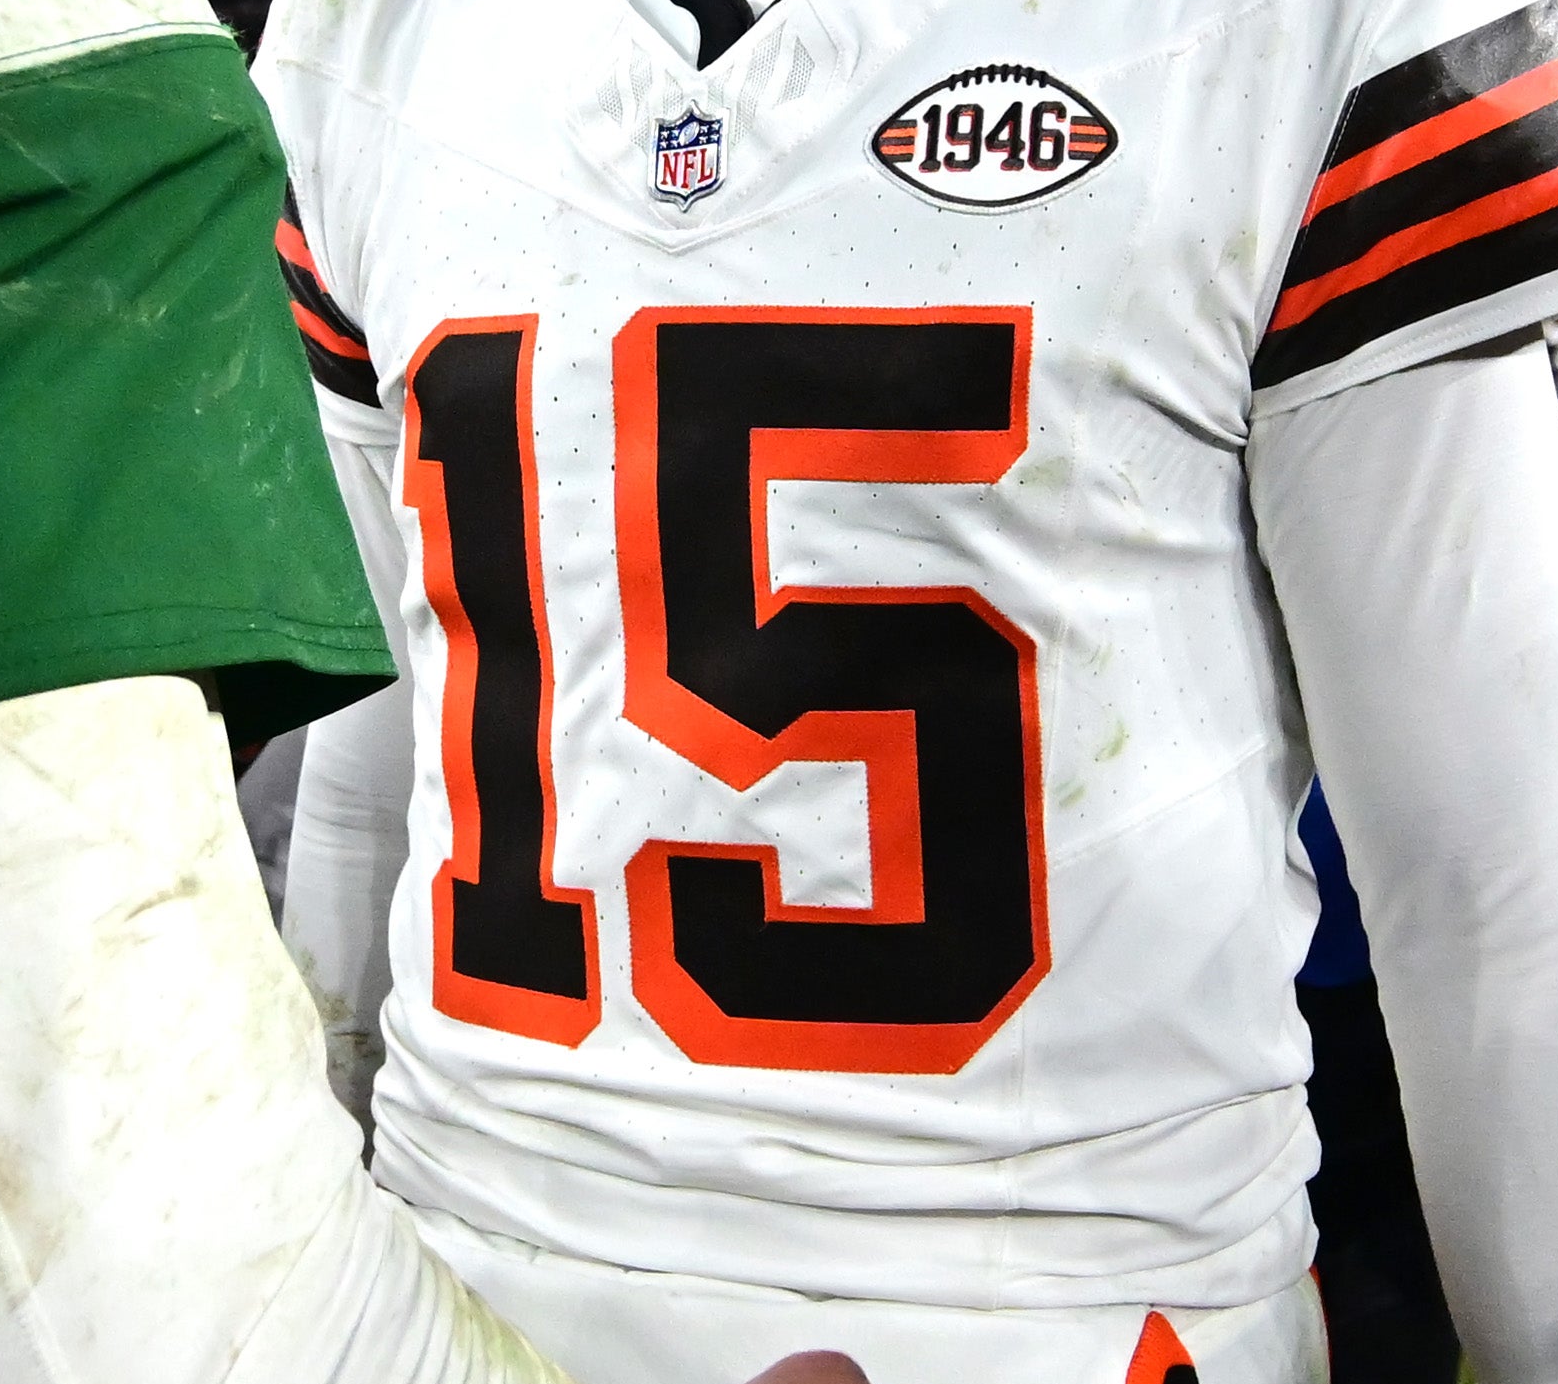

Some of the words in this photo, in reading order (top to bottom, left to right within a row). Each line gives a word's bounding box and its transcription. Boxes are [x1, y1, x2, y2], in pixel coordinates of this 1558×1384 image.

[660, 152, 713, 189] NFL
[919, 99, 1071, 176] 1946
[401, 305, 1051, 1073] 15
